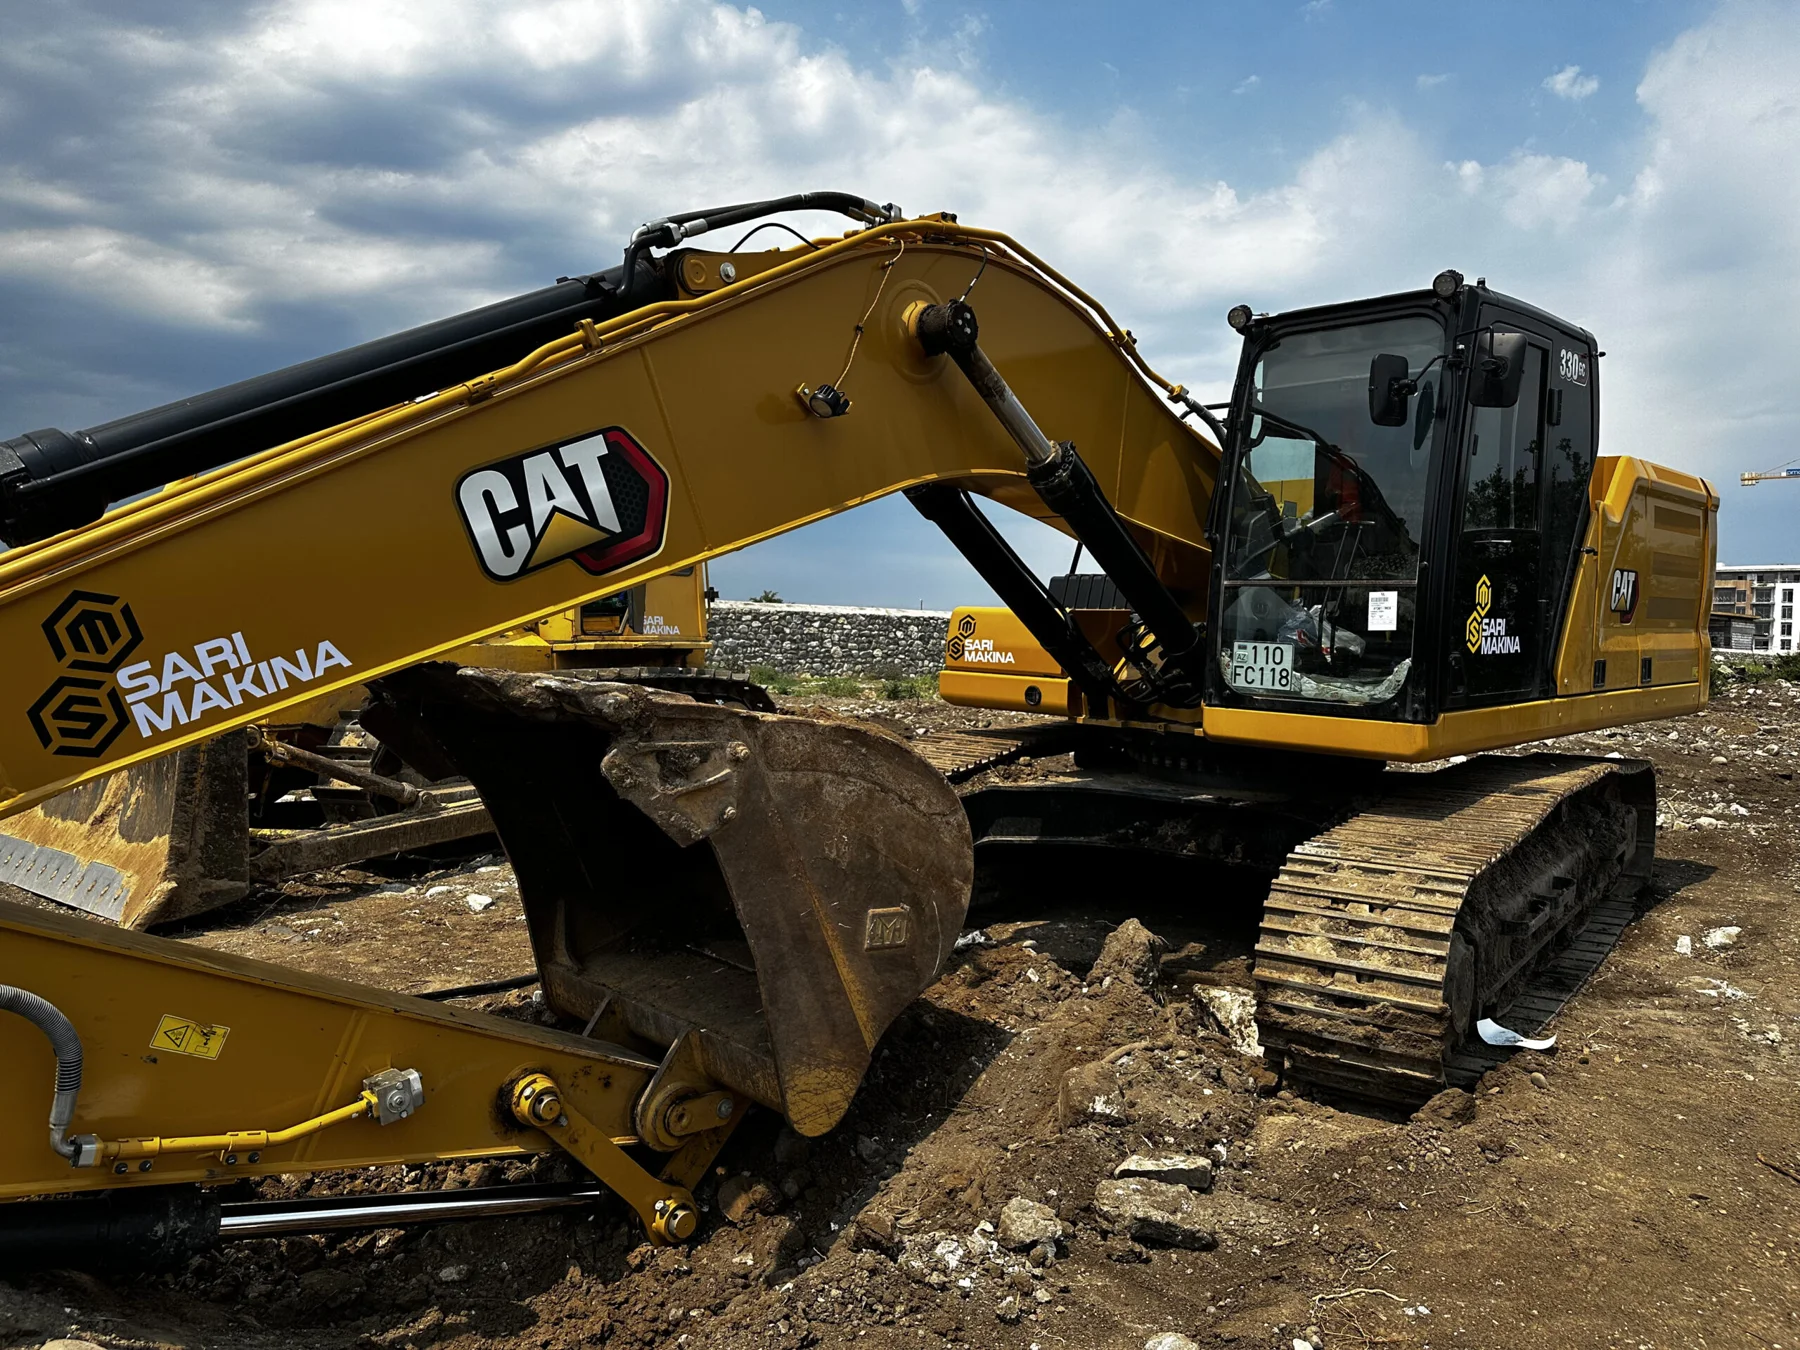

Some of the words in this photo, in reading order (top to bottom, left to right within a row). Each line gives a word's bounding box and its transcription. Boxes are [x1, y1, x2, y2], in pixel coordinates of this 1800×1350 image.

[1560, 348, 1579, 380] 330
[459, 433, 623, 577] CAT
[1611, 569, 1636, 611] CAT
[643, 625, 681, 635] MAKINA
[1481, 618, 1506, 636] SARI
[964, 639, 994, 651] SARI
[1236, 653, 1247, 661] AZ
[1251, 644, 1284, 666] 110
[1480, 635, 1521, 655] MAKINA
[116, 631, 253, 704] SARI
[964, 650, 1015, 664] MAKINA
[1233, 665, 1290, 687] FC118
[130, 639, 353, 738] MAKINA
